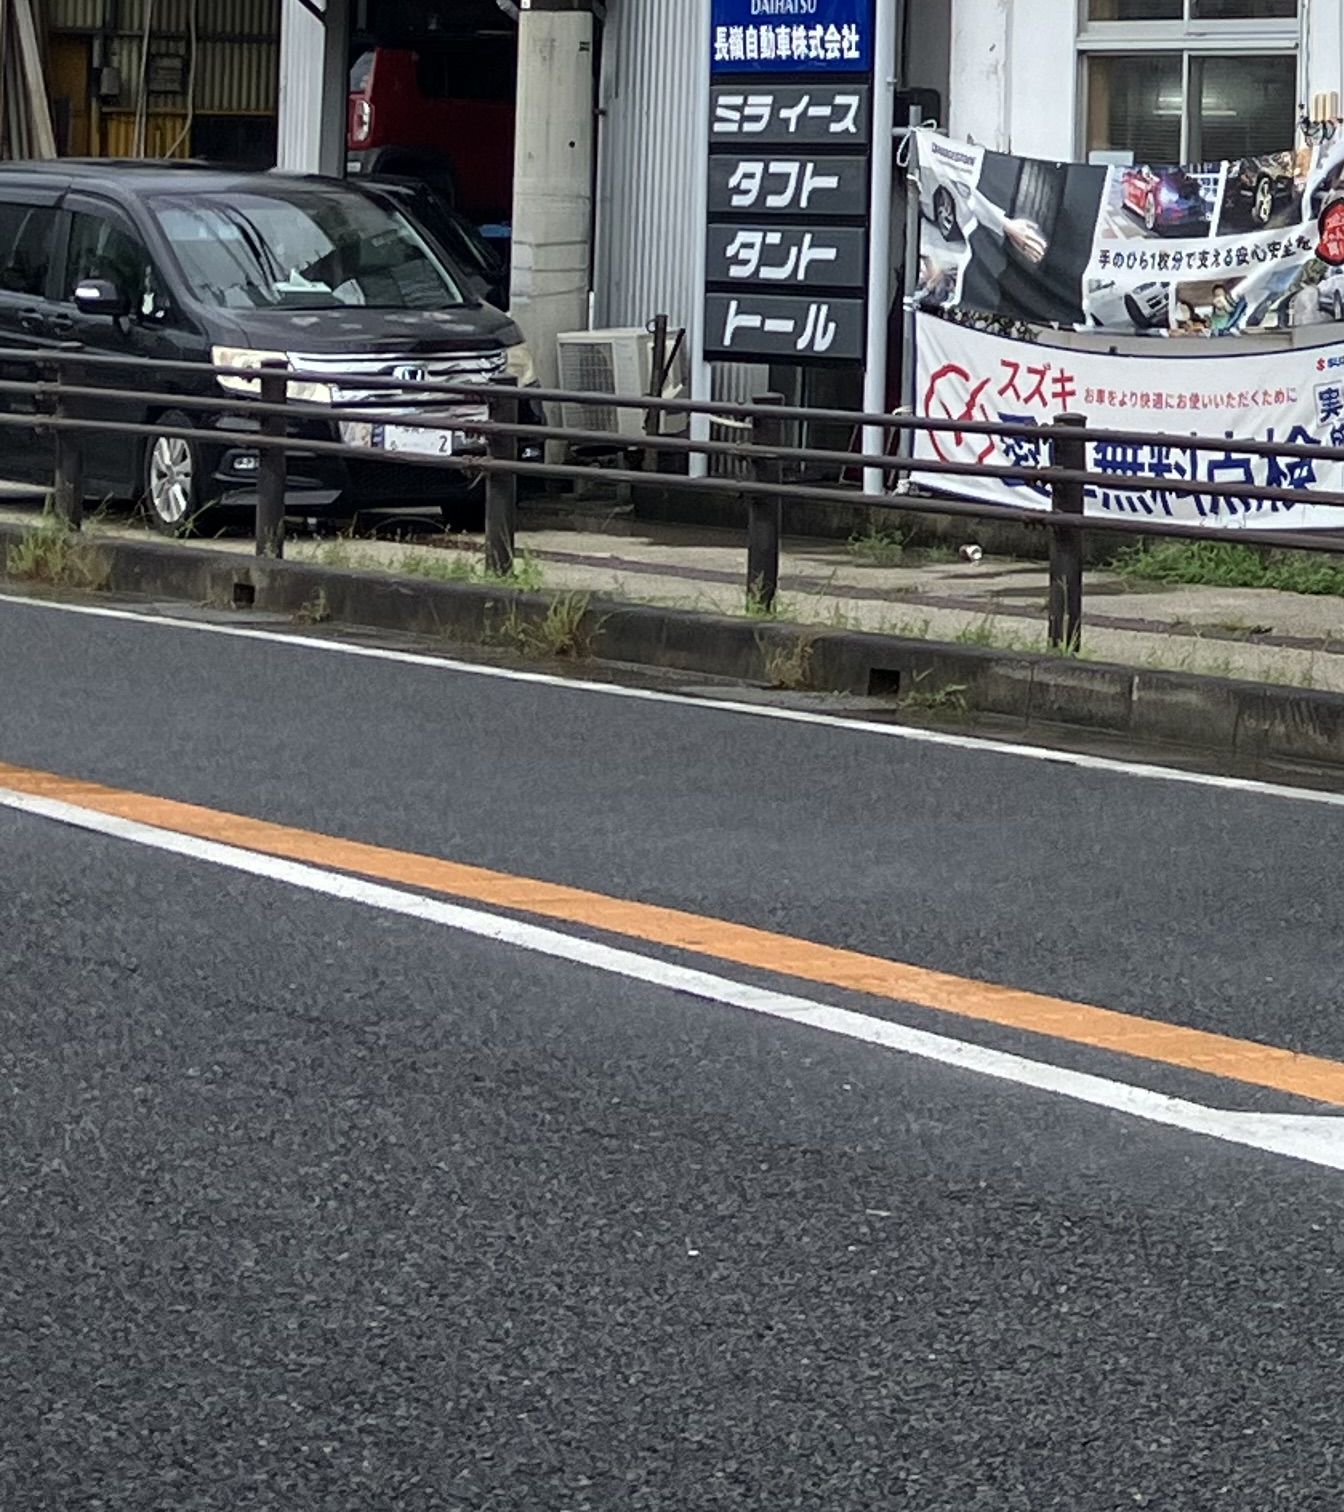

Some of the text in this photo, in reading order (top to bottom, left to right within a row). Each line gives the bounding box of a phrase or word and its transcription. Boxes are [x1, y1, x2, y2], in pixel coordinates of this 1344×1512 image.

[713, 22, 861, 62] 長嶺自動車株式会社
[712, 94, 861, 134] ミライース
[727, 161, 839, 209] タフト
[724, 230, 837, 281] タント
[722, 299, 836, 352] トール
[997, 358, 1076, 412] スズキ
[996, 411, 1322, 517] 愛無料点検
